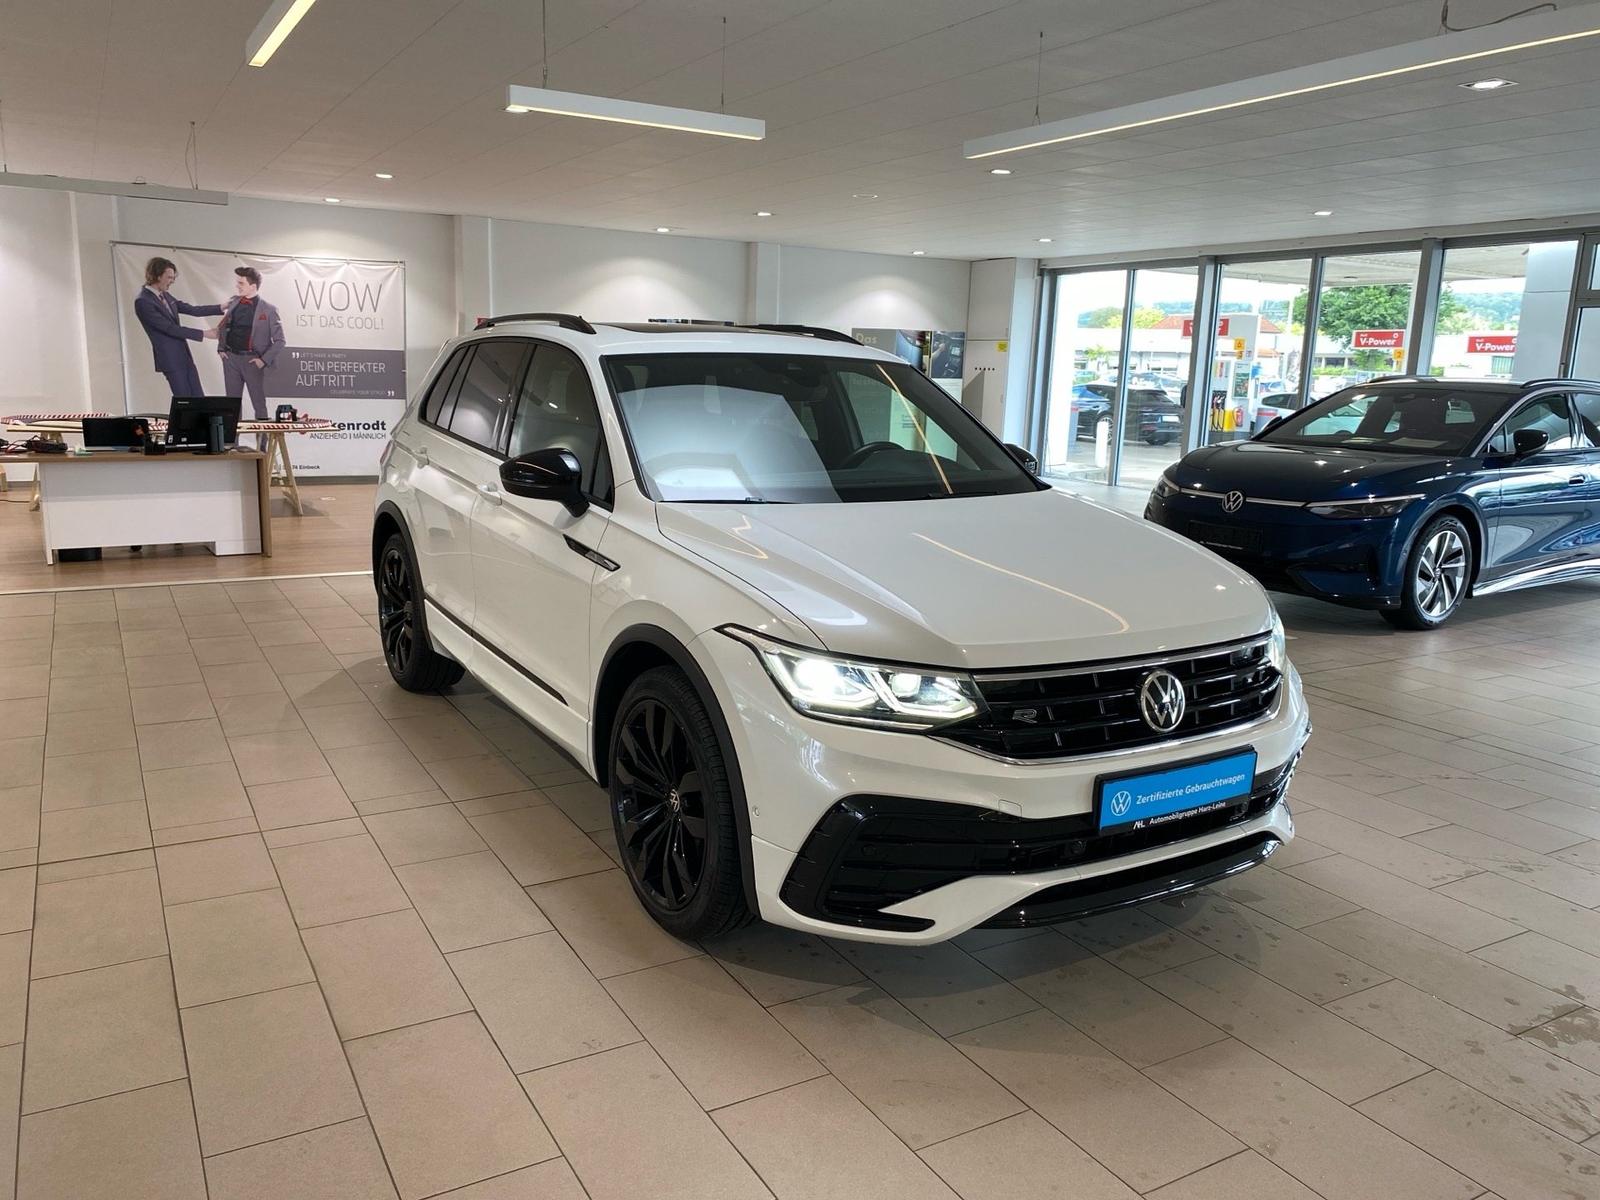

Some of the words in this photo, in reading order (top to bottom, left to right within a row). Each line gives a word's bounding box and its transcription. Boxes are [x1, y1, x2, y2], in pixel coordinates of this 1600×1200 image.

[294, 279, 382, 313] WOW
[296, 314, 316, 328] IST
[319, 315, 345, 329] DAS
[347, 316, 385, 330] COOL!
[856, 332, 878, 344] Das
[1360, 337, 1397, 346] V-Power
[1475, 342, 1516, 352] V-Power
[300, 360, 325, 372] DEIN
[327, 361, 386, 373] PERFEKTER
[295, 374, 356, 387] AUFTRITT
[310, 432, 348, 440] ANZIEHEND
[353, 431, 386, 440] MÄNNLICH
[1136, 787, 1184, 805] Zertifizierte
[1185, 774, 1246, 795] Gebrauchtwagen
[1149, 808, 1198, 826] Automobilgruppe
